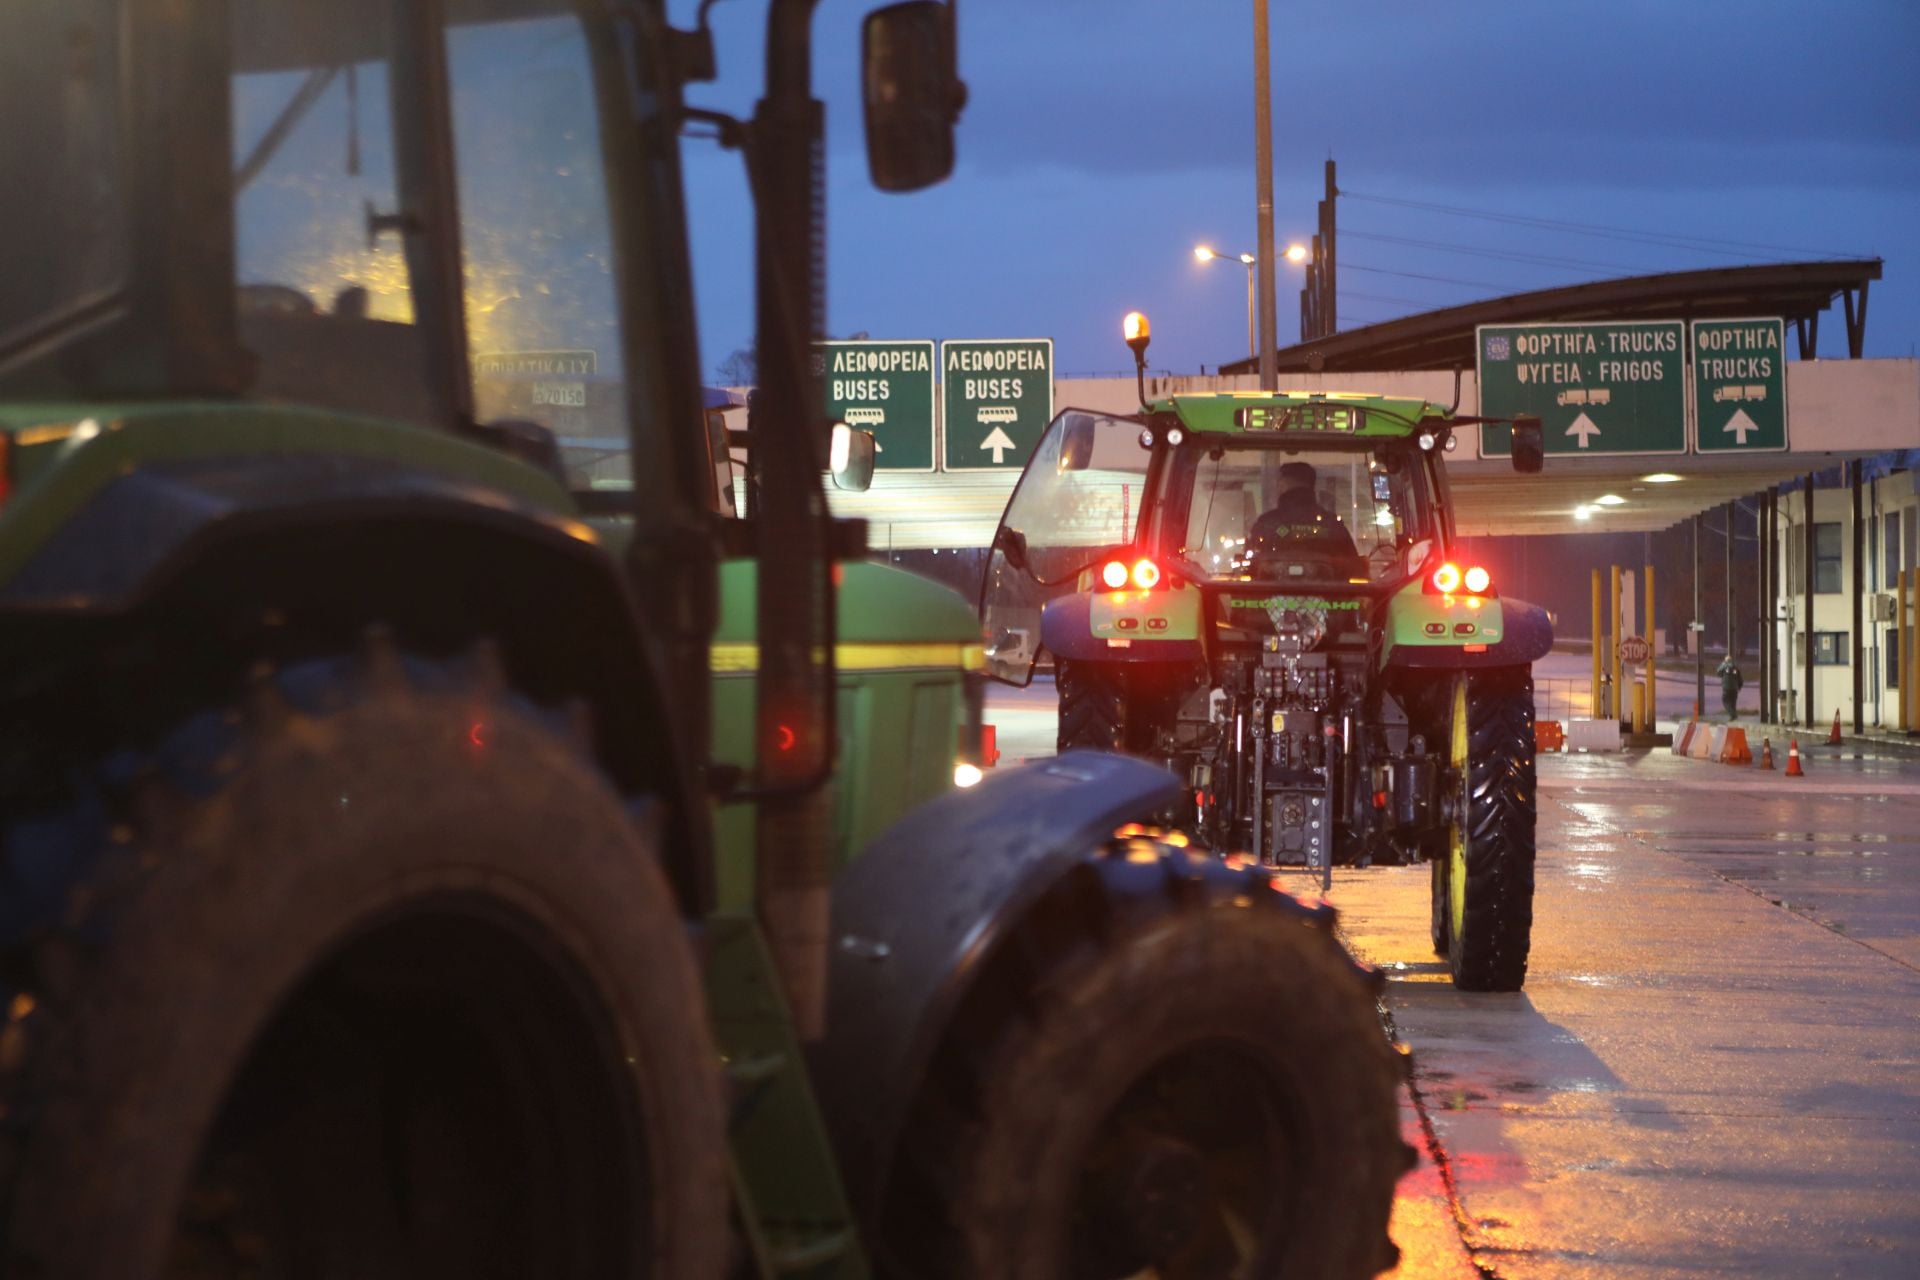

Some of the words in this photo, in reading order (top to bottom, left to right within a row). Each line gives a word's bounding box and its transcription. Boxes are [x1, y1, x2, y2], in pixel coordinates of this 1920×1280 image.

[1516, 334, 1597, 356] ΦΟΡΤΗΓΑ
[1608, 331, 1677, 353] TRUCKS
[1699, 327, 1778, 350] ΦΟΡΤΗΓΑ
[833, 351, 929, 373] ΛΕΩΦΟΡΕΙΑ
[948, 350, 1045, 372] ΛΕΩΦΟΡΕΙΑ
[1701, 357, 1772, 380] TRUCKS
[1517, 362, 1582, 385] ΨΥΓΕΙΑ
[1600, 360, 1664, 382] FRIGOS
[833, 380, 890, 401] BUSES
[965, 378, 1023, 399] BUSES
[1621, 643, 1647, 659] STOP
